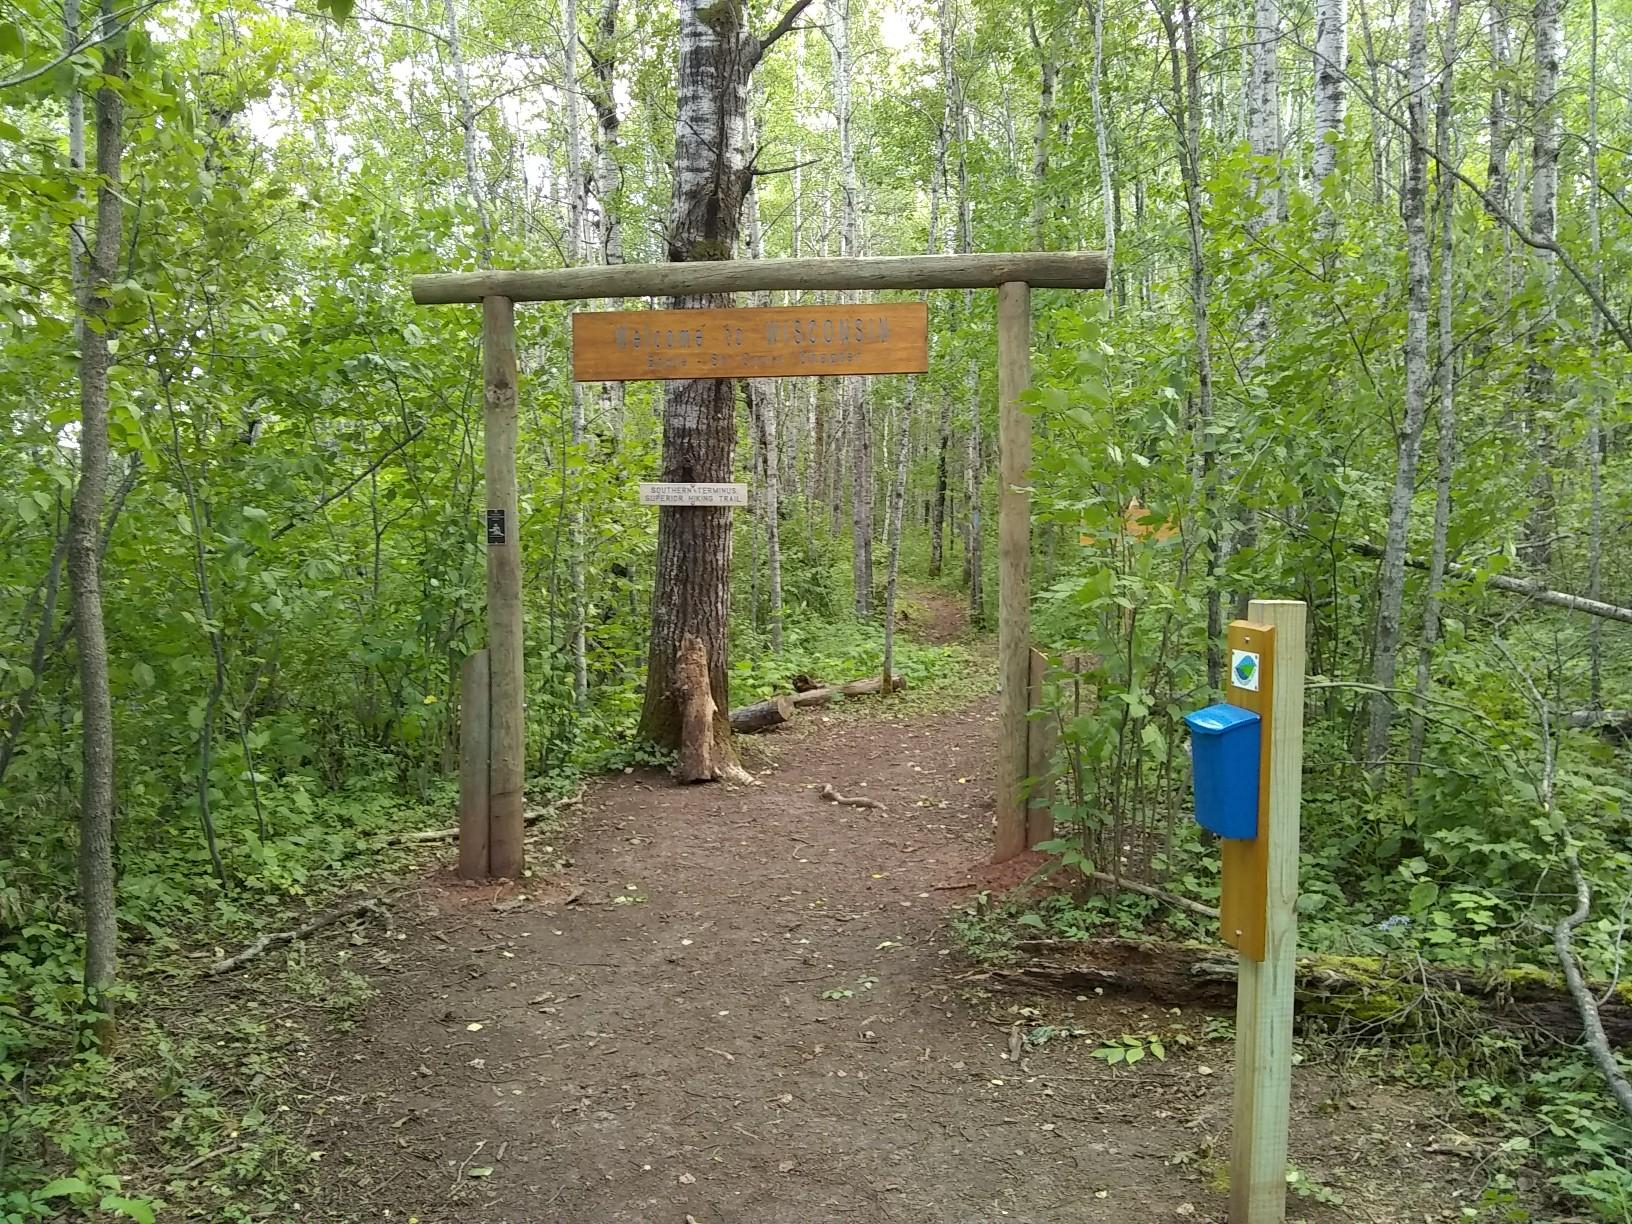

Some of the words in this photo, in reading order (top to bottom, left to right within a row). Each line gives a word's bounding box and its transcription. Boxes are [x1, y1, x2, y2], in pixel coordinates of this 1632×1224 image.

[616, 322, 704, 350] Welcome
[725, 326, 744, 347] to
[766, 317, 890, 345] WISCONSIN
[651, 486, 692, 494] SOUTHERN
[697, 487, 737, 495] TERMINUS
[645, 494, 683, 502] SUPERIOR
[719, 495, 742, 503] TRAIL
